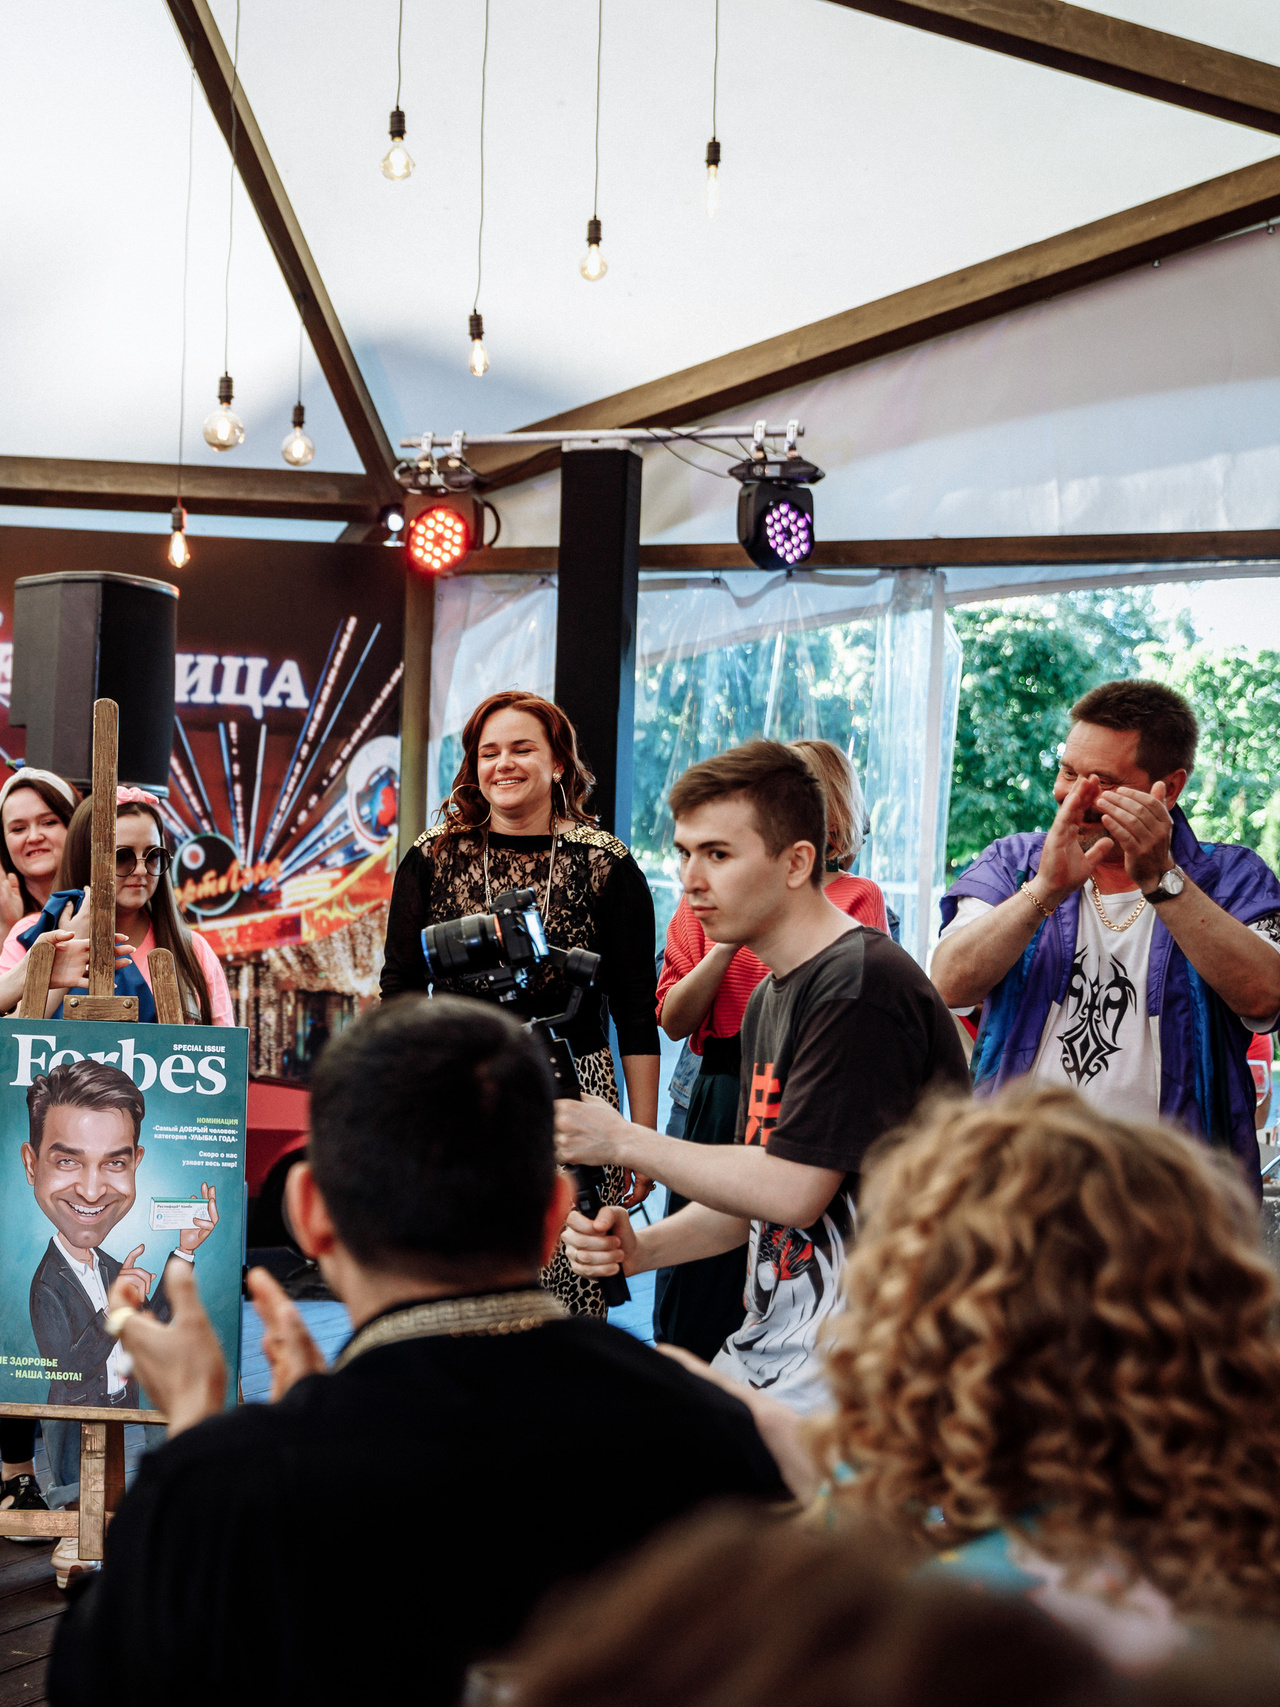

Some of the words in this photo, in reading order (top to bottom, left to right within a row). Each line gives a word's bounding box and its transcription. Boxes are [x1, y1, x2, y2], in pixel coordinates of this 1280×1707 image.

[173, 1043, 203, 1053] SPECIAL
[204, 1045, 226, 1053] ISSUE
[196, 1117, 239, 1126] НОМИНАЦИЯ
[179, 1125, 208, 1133] ДОБРЫЙ
[198, 1151, 219, 1159] Скоро
[9, 1356, 58, 1367] ЗДОРОВЬЕ
[15, 1369, 43, 1380] НАША
[44, 1371, 83, 1381] ЗАБОТА!
